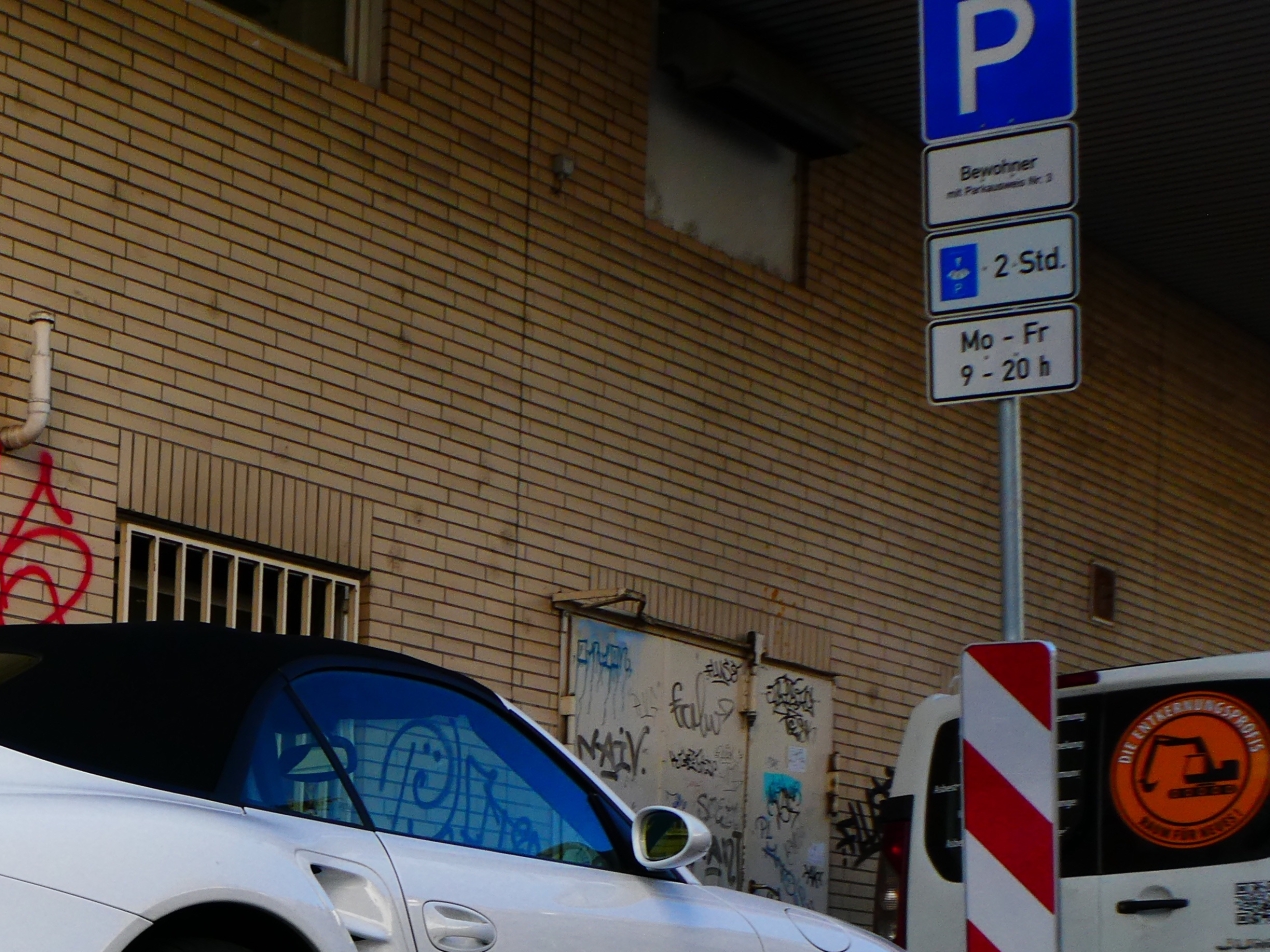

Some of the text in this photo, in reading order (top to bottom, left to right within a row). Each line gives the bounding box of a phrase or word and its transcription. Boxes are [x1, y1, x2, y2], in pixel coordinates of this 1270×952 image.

[957, 0, 1035, 116] P
[960, 157, 1038, 181] Bewohner
[994, 246, 1066, 278] 2 Std.
[961, 329, 994, 353] Mo
[1024, 321, 1049, 344] Fr
[960, 364, 974, 386] 9
[1002, 357, 1030, 382] 20
[1039, 355, 1050, 377] h
